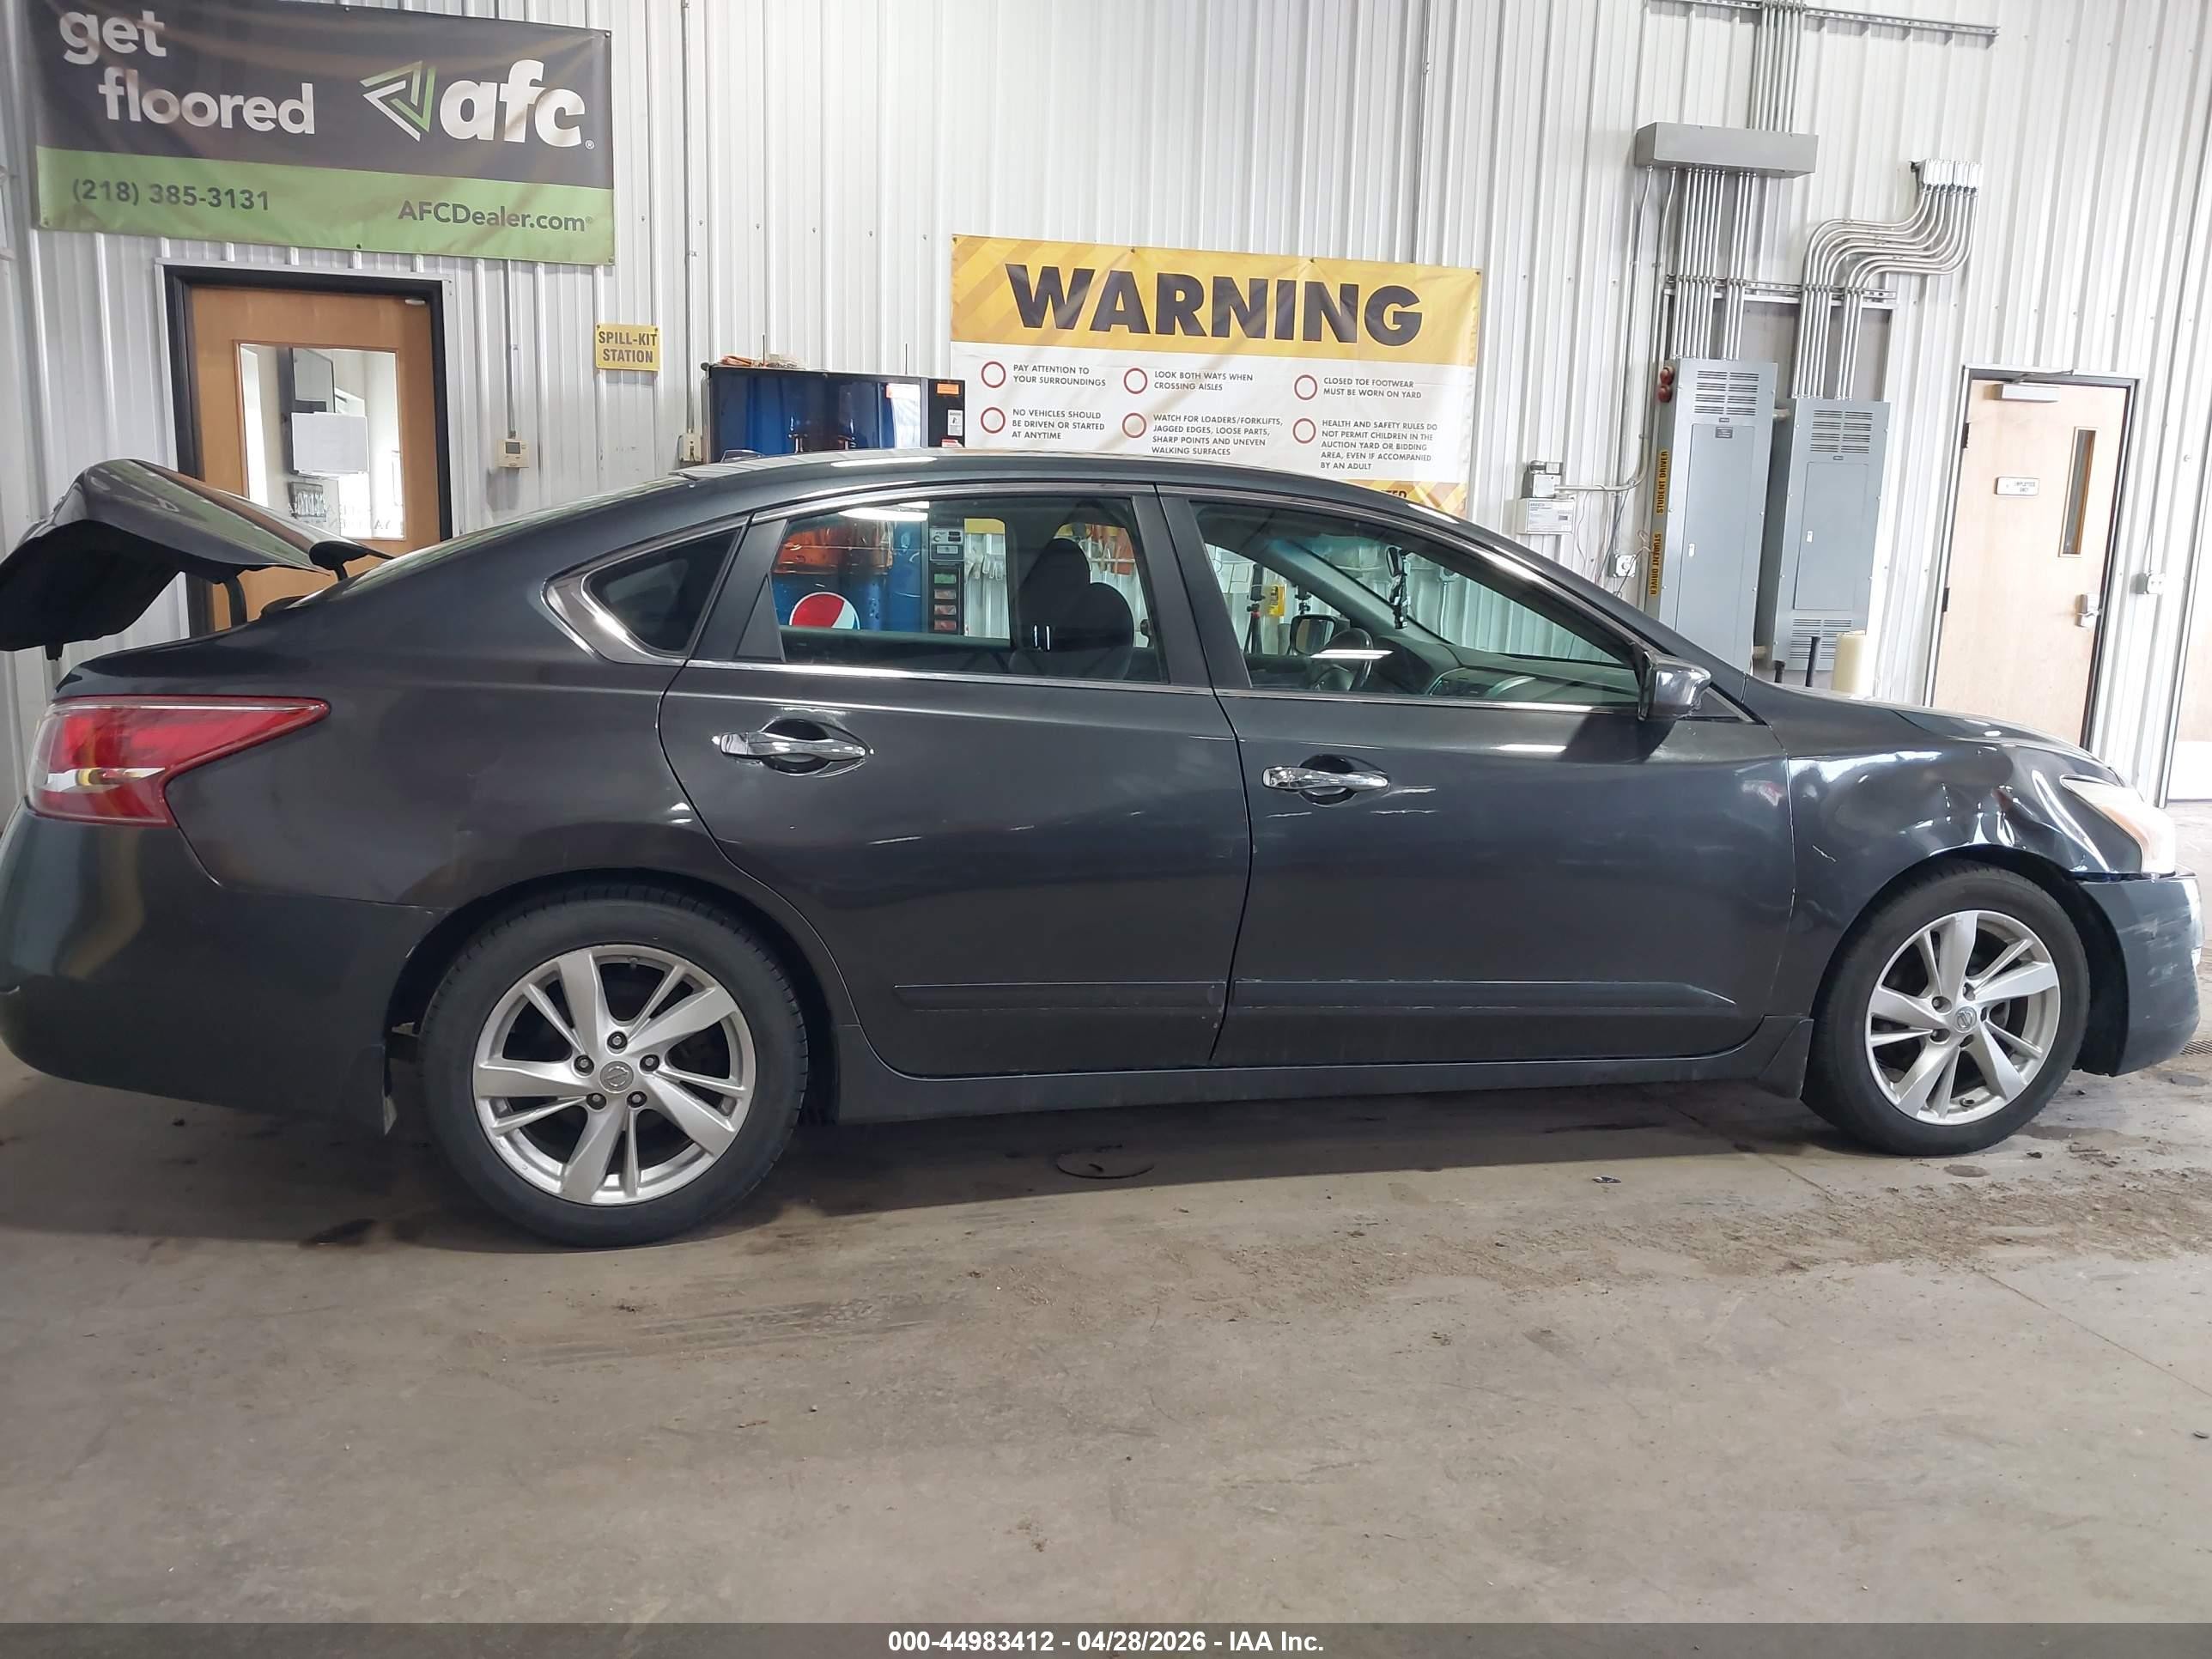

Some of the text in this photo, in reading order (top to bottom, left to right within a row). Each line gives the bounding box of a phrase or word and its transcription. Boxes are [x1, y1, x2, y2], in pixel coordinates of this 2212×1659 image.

[59, 10, 167, 64] get
[98, 66, 315, 135] floored
[73, 179, 268, 210] (218) 385-3131
[1005, 264, 1423, 347] WARNING
[599, 331, 657, 346] SPILL-KIT
[603, 349, 653, 362] STATION
[1032, 365, 1075, 374] ATTENTION
[1040, 377, 1106, 386] SURROUNDINGS
[1371, 380, 1413, 388] FOOTWEAR
[1201, 416, 1283, 426] LOADERS/FORKLIFTS,
[1187, 426, 1213, 434] EDGES,
[1656, 451, 1668, 514] STUDENT DRIVER
[1650, 568, 1658, 595] DRIVER
